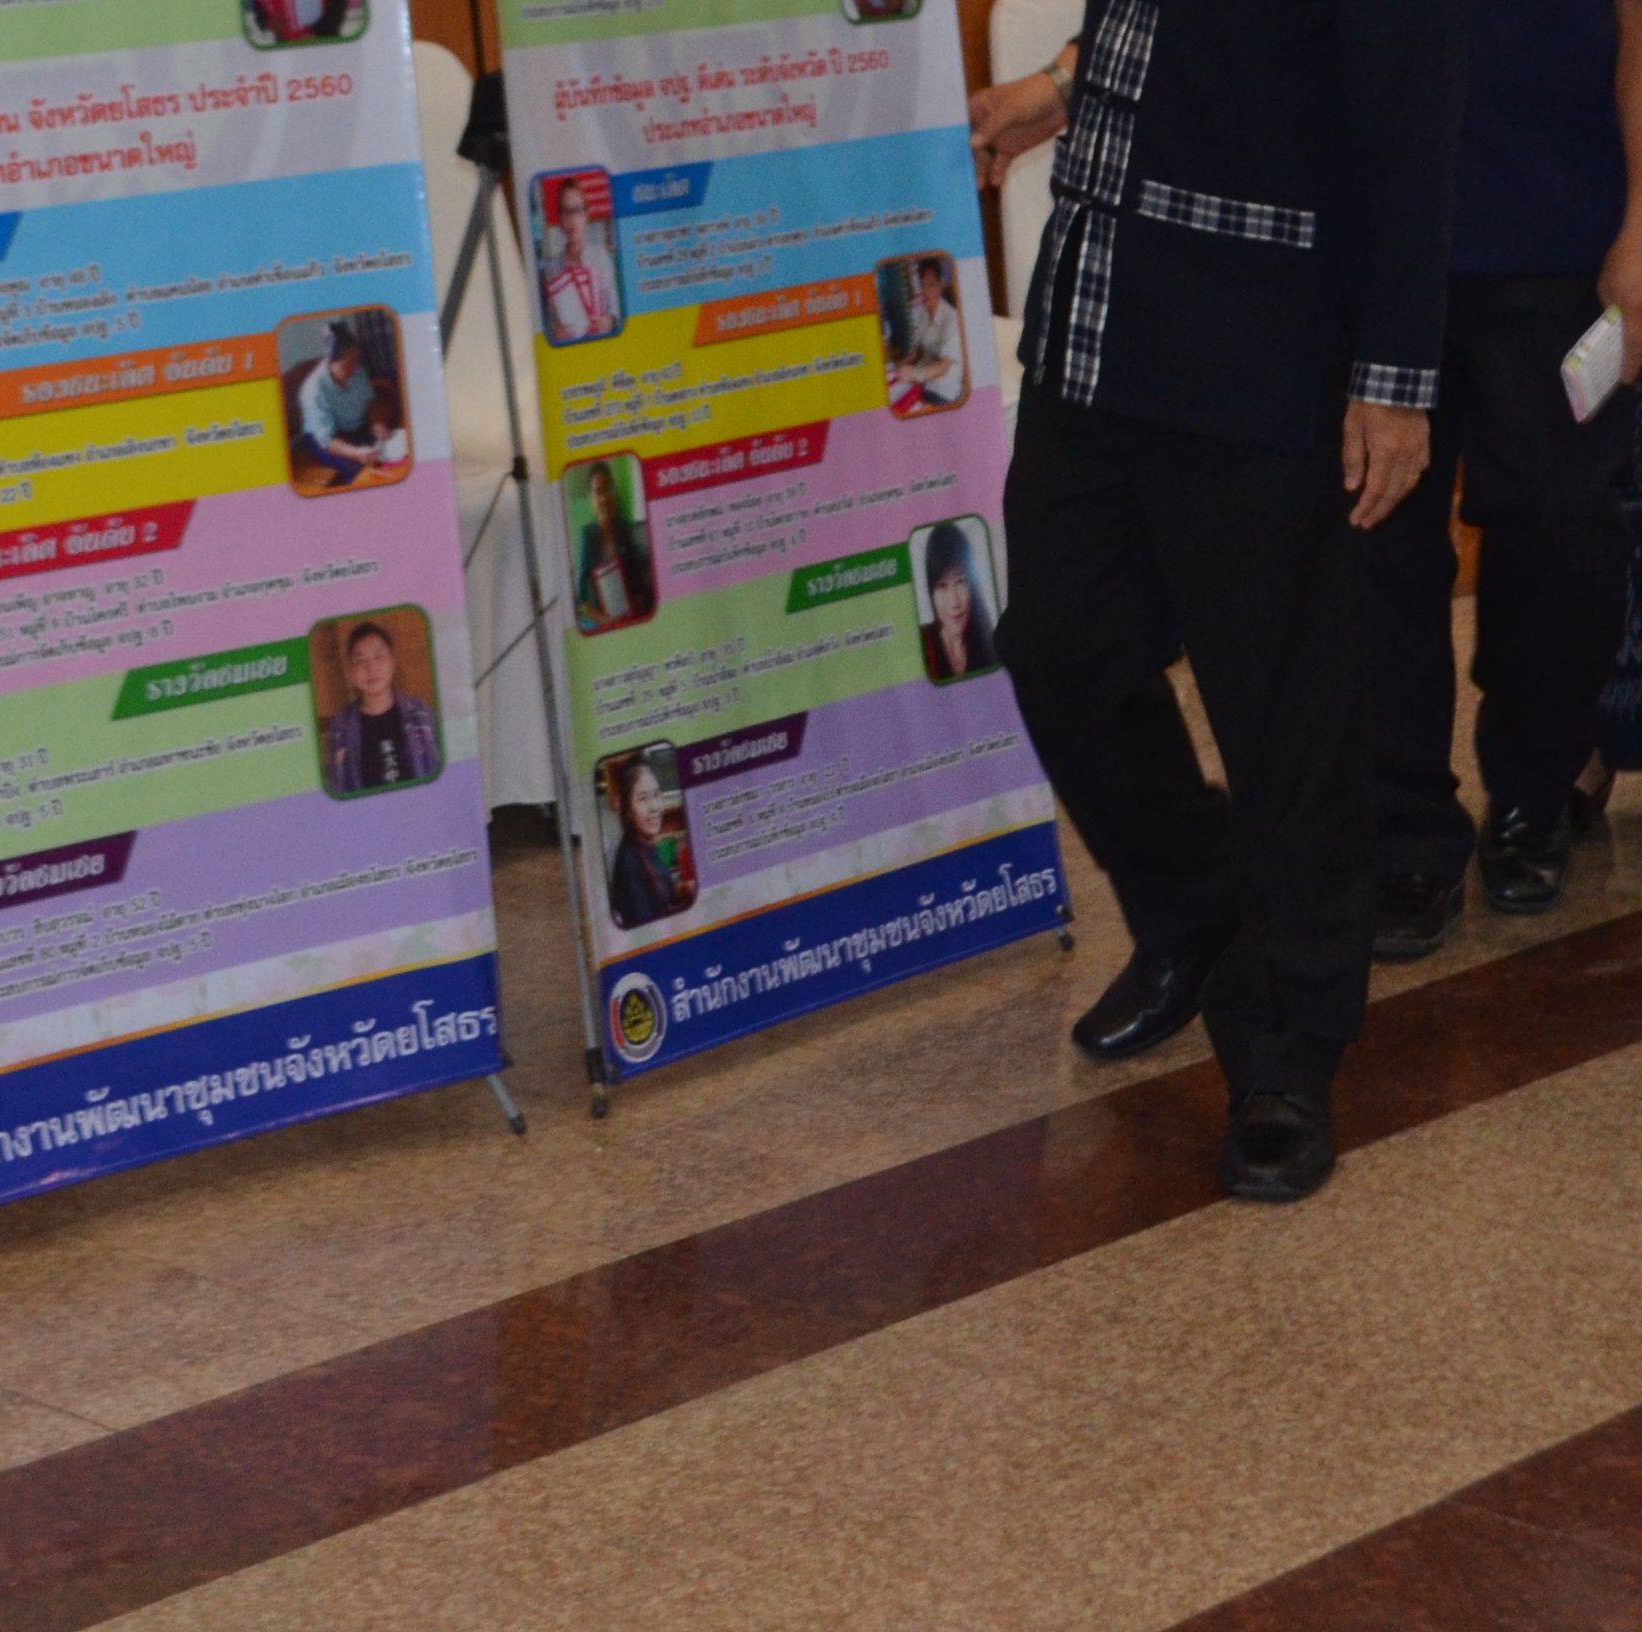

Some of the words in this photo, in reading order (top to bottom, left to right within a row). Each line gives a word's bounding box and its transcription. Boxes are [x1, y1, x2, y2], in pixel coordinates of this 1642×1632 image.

[741, 50, 827, 86] ระดับจังหวัด
[830, 46, 843, 75] ปี
[846, 49, 889, 73] 2560
[27, 82, 181, 131] จังหวัดยโสธร
[187, 71, 279, 114] ประจำปี
[286, 72, 354, 103] 2560
[143, 522, 158, 543] 2
[669, 862, 1057, 1023] สำนักงานพัฒนาชุมชนจังหวัดยโสธร
